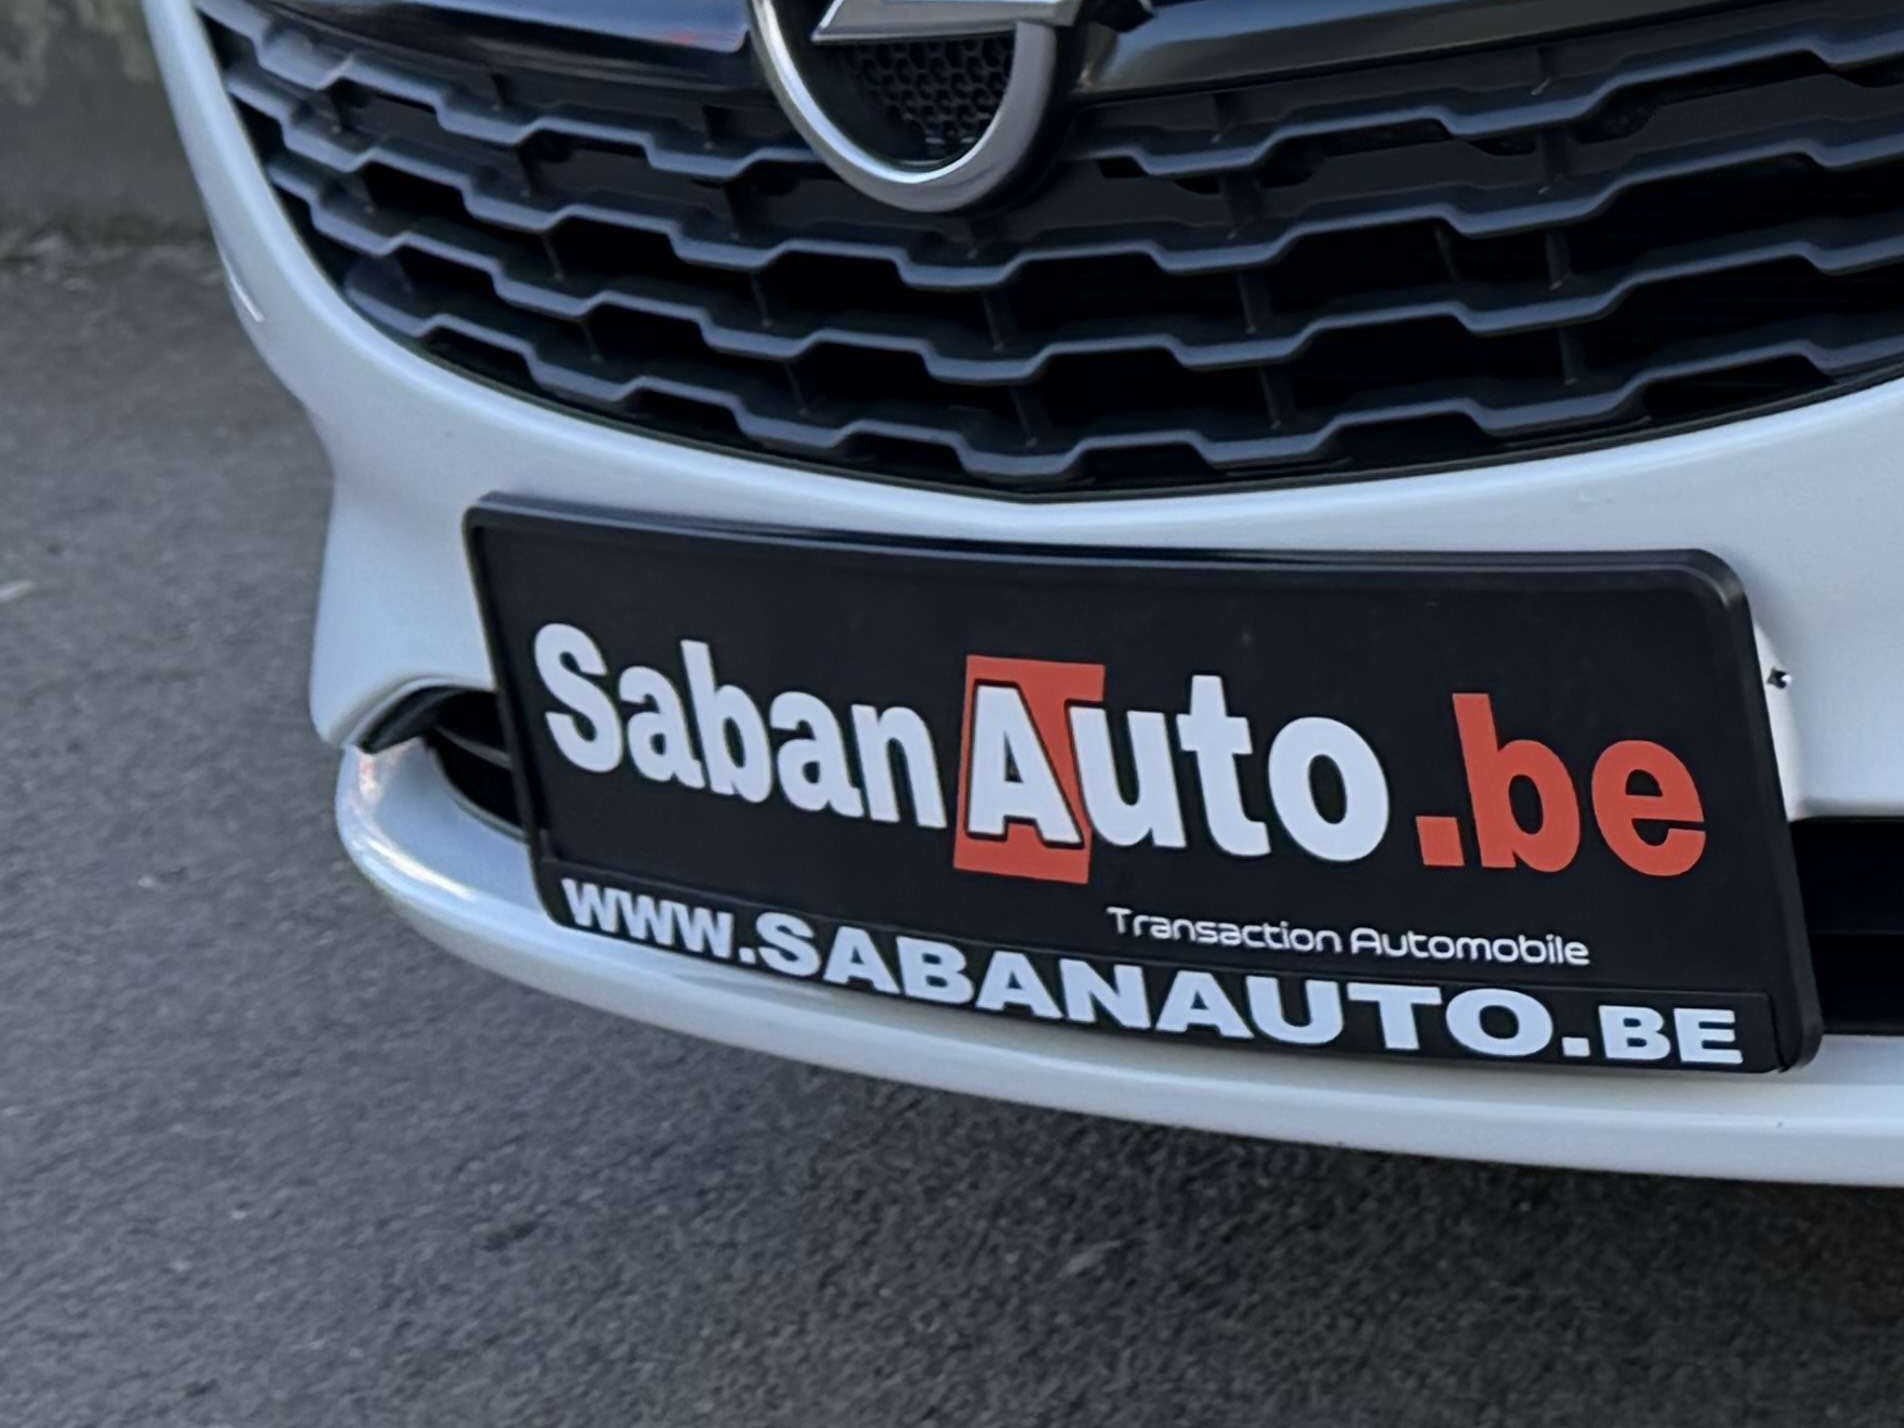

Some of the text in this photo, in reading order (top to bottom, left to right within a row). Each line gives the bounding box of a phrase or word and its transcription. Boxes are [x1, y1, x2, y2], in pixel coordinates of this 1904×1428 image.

[532, 622, 1707, 876] SabanAuto.be
[1106, 905, 1593, 966] Transaction Automobile
